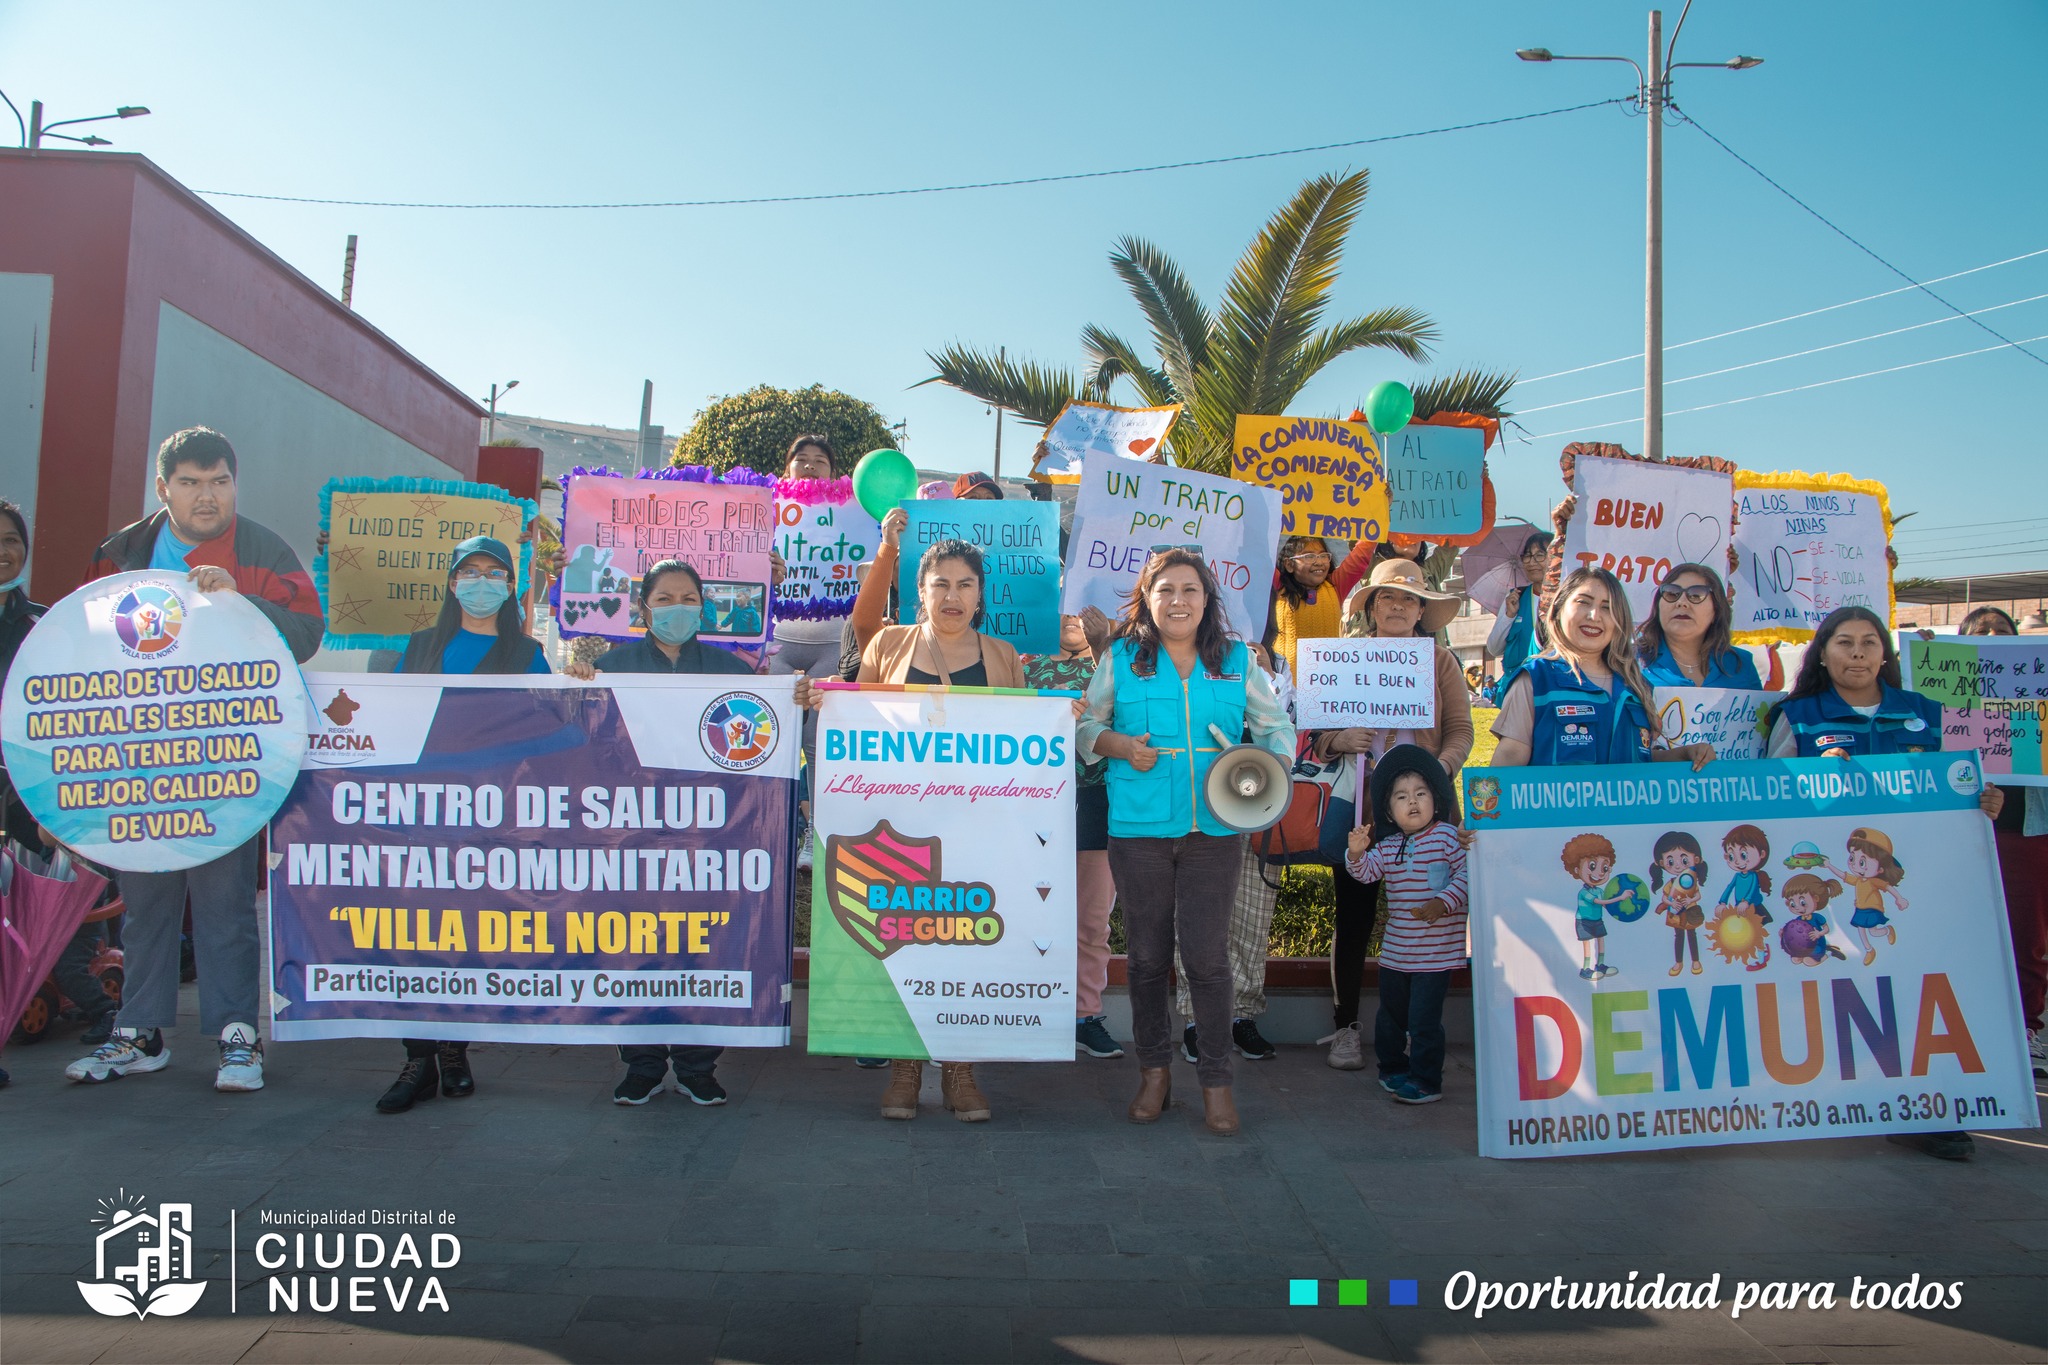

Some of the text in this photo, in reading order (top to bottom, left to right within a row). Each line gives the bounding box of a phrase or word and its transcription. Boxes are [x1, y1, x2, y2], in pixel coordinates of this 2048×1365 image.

[1233, 447, 1262, 472] LA
[1402, 434, 1427, 460] AL
[1256, 455, 1373, 491] COMIENSA
[1386, 468, 1468, 491] ALTRATO
[1107, 471, 1244, 521] UN TRATO
[1333, 484, 1360, 507] EL
[1741, 496, 1751, 512] A
[1761, 494, 1788, 511] LOS
[724, 502, 767, 531] POR
[816, 507, 833, 527] al
[1130, 511, 1203, 539] por el
[1307, 513, 1381, 541] TRATO
[1594, 499, 1664, 530] BUEN
[596, 522, 769, 553] EL BUEN TRATO
[776, 532, 866, 562] ltrato
[972, 523, 993, 546] SU
[1808, 541, 1825, 555] SE
[377, 550, 421, 569] BUEN
[832, 564, 853, 580] SI
[999, 555, 1046, 575] HIJOS
[1753, 545, 1794, 597] NO
[824, 580, 860, 597] TRAT
[1812, 567, 1829, 585] SE
[993, 583, 1013, 605] LA
[1814, 594, 1830, 609] SE
[1753, 608, 1779, 622] ALTO
[1366, 650, 1419, 665] UNIDOS
[1917, 646, 1934, 670] A
[25, 661, 279, 702] CUIDAR DE TU SALUD
[1309, 673, 1415, 688] POR EL BUEN
[28, 698, 281, 738] MENTAL ES ESENCIAL
[701, 693, 777, 731] Centro de Salud Mental Comunitario
[1320, 701, 1367, 714] TRATO
[307, 733, 376, 750] TACNA
[1943, 725, 1971, 736] con
[53, 735, 260, 773] PARA TENER UNA
[825, 729, 1066, 767] BIENVENIDOS
[59, 770, 258, 808] MEJOR CALIDAD
[823, 773, 1067, 804] ¡Llegamos para quedarnos!
[1511, 769, 1938, 810] MUNICIPALIDAD DISTRITAL DE CIUDAD NUEVA
[333, 781, 726, 830] CENTRO DE SALUD
[110, 811, 214, 841] DE VIDA.
[287, 843, 772, 893] MENTALCOMUNITARIO
[868, 884, 990, 913] BARRIO
[330, 906, 730, 954] “VILLA DEL NORTE”
[879, 917, 999, 942] SEGURO
[313, 967, 744, 1003] Participación Social y Comunitaria
[941, 981, 966, 997] DE
[936, 1012, 1042, 1027] CIUDAD NUEVA
[1514, 973, 1986, 1101] DEMUNA
[1508, 1092, 2006, 1146] HORARIO DE ATENCIÓN: 7:30 a.m. a 3:30 p.m.
